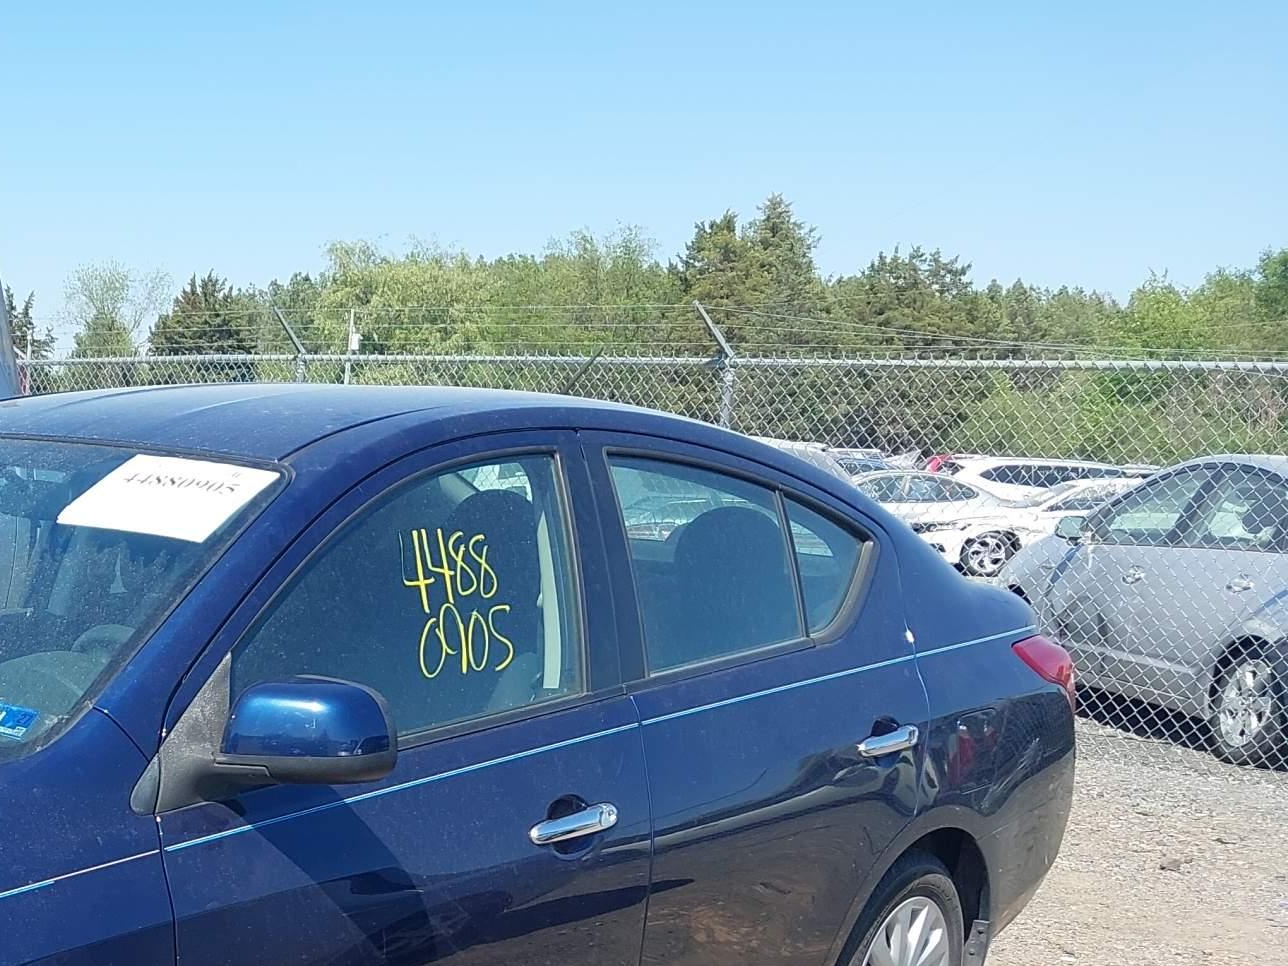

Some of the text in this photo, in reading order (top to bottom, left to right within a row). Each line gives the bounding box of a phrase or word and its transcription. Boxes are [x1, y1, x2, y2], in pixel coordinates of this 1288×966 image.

[124, 472, 241, 495] 44880905
[398, 528, 498, 614] 4488
[419, 603, 514, 678] 0905
